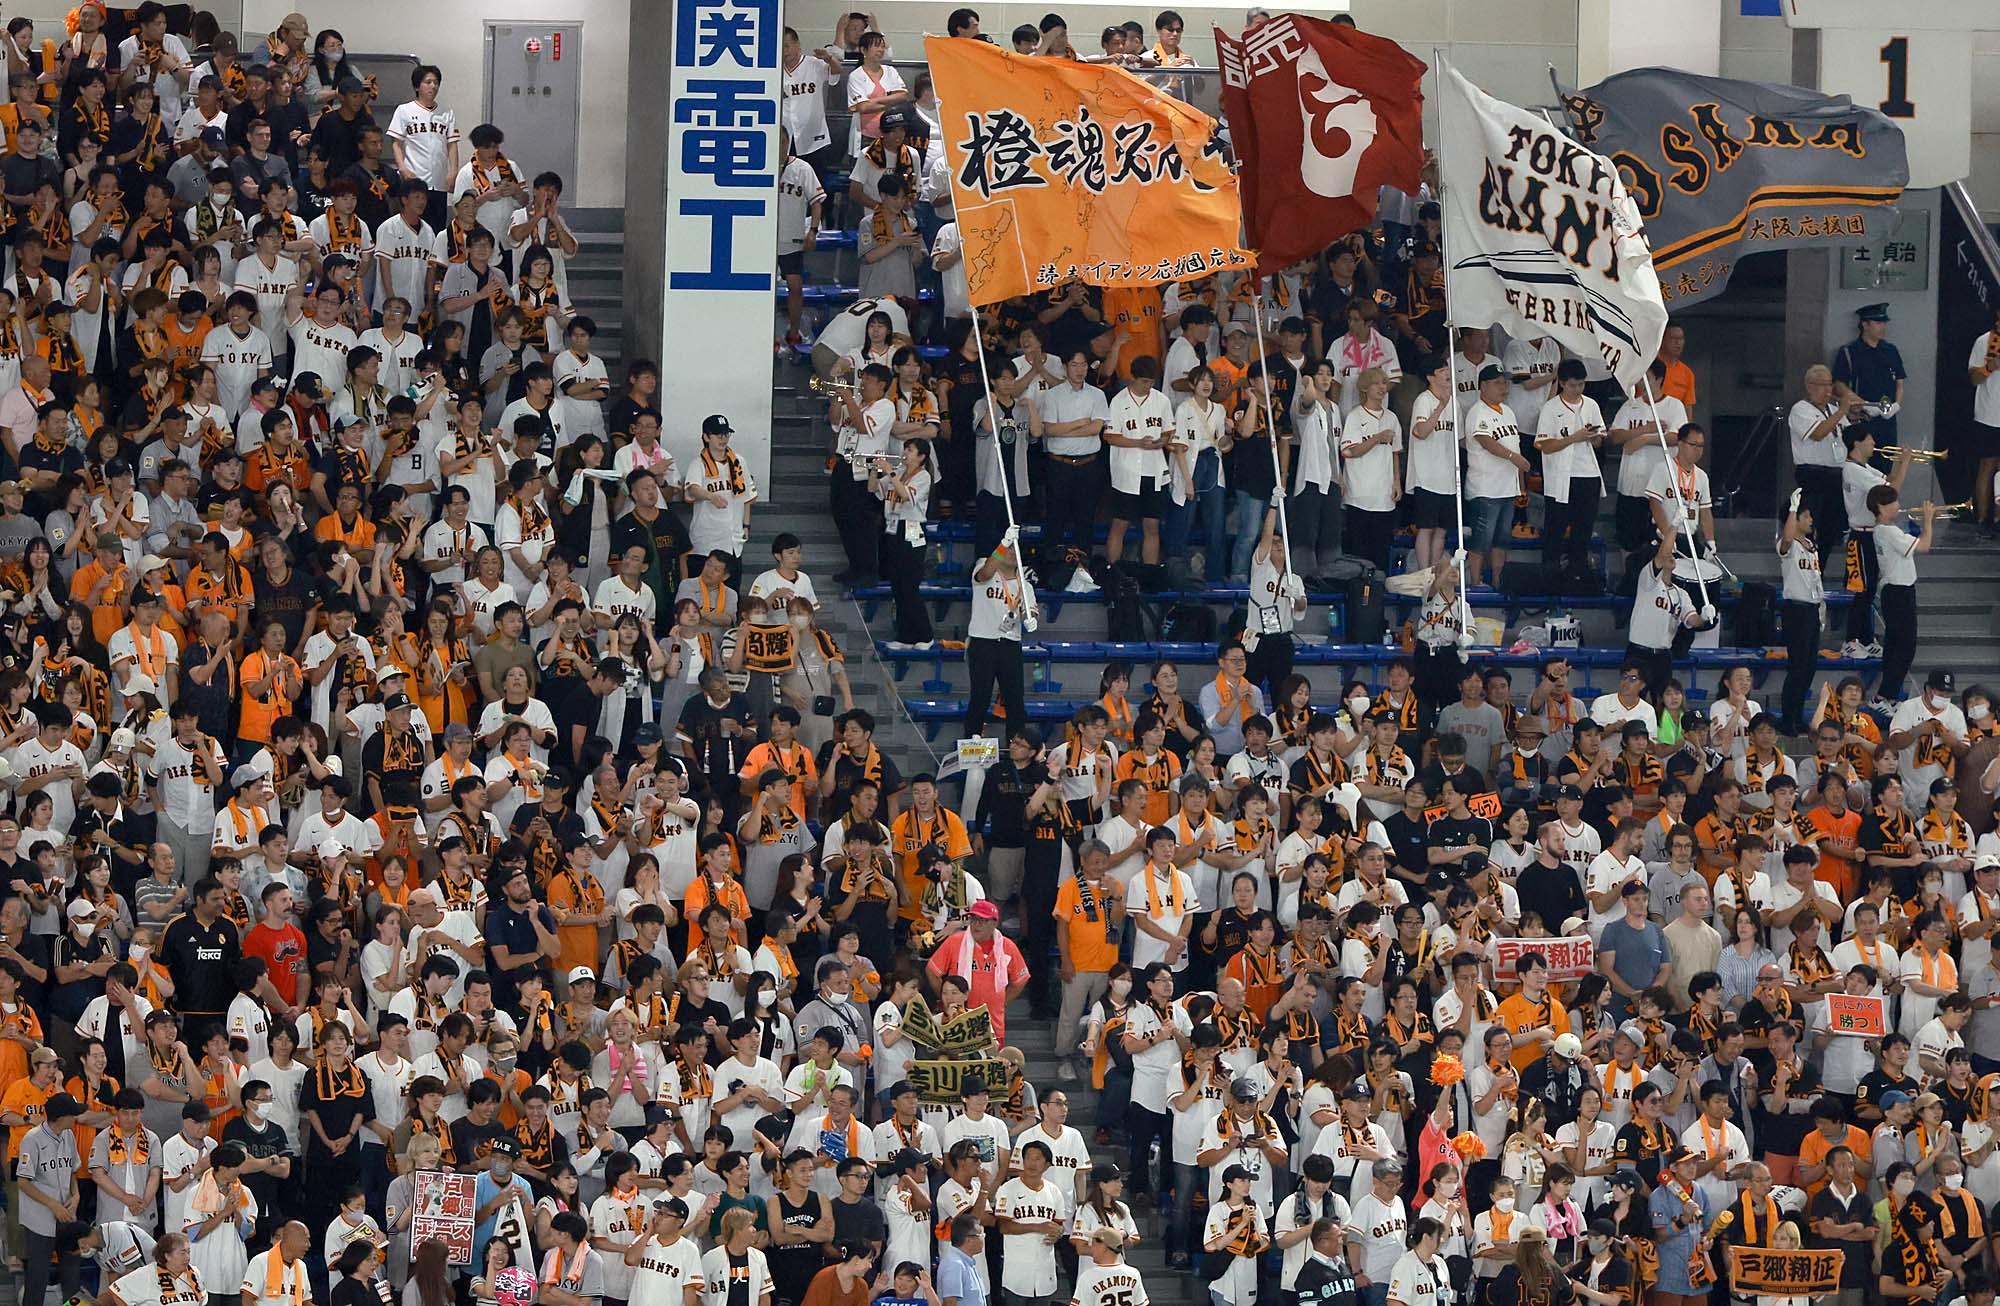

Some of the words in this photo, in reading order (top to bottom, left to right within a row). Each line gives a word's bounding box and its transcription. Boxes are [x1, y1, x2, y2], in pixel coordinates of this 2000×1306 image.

[1880, 37, 1917, 117] 1
[406, 122, 450, 136] GIANT
[670, 0, 777, 290] 関電工
[1479, 156, 1621, 282] GIANT
[1750, 214, 1865, 240] 大阪応援団
[394, 247, 430, 260] GIANT
[218, 351, 262, 364] TOKY
[411, 454, 422, 470] B
[1739, 1254, 1835, 1282] 戸郷翔征
[1092, 1275, 1138, 1294] OKAMOTO
